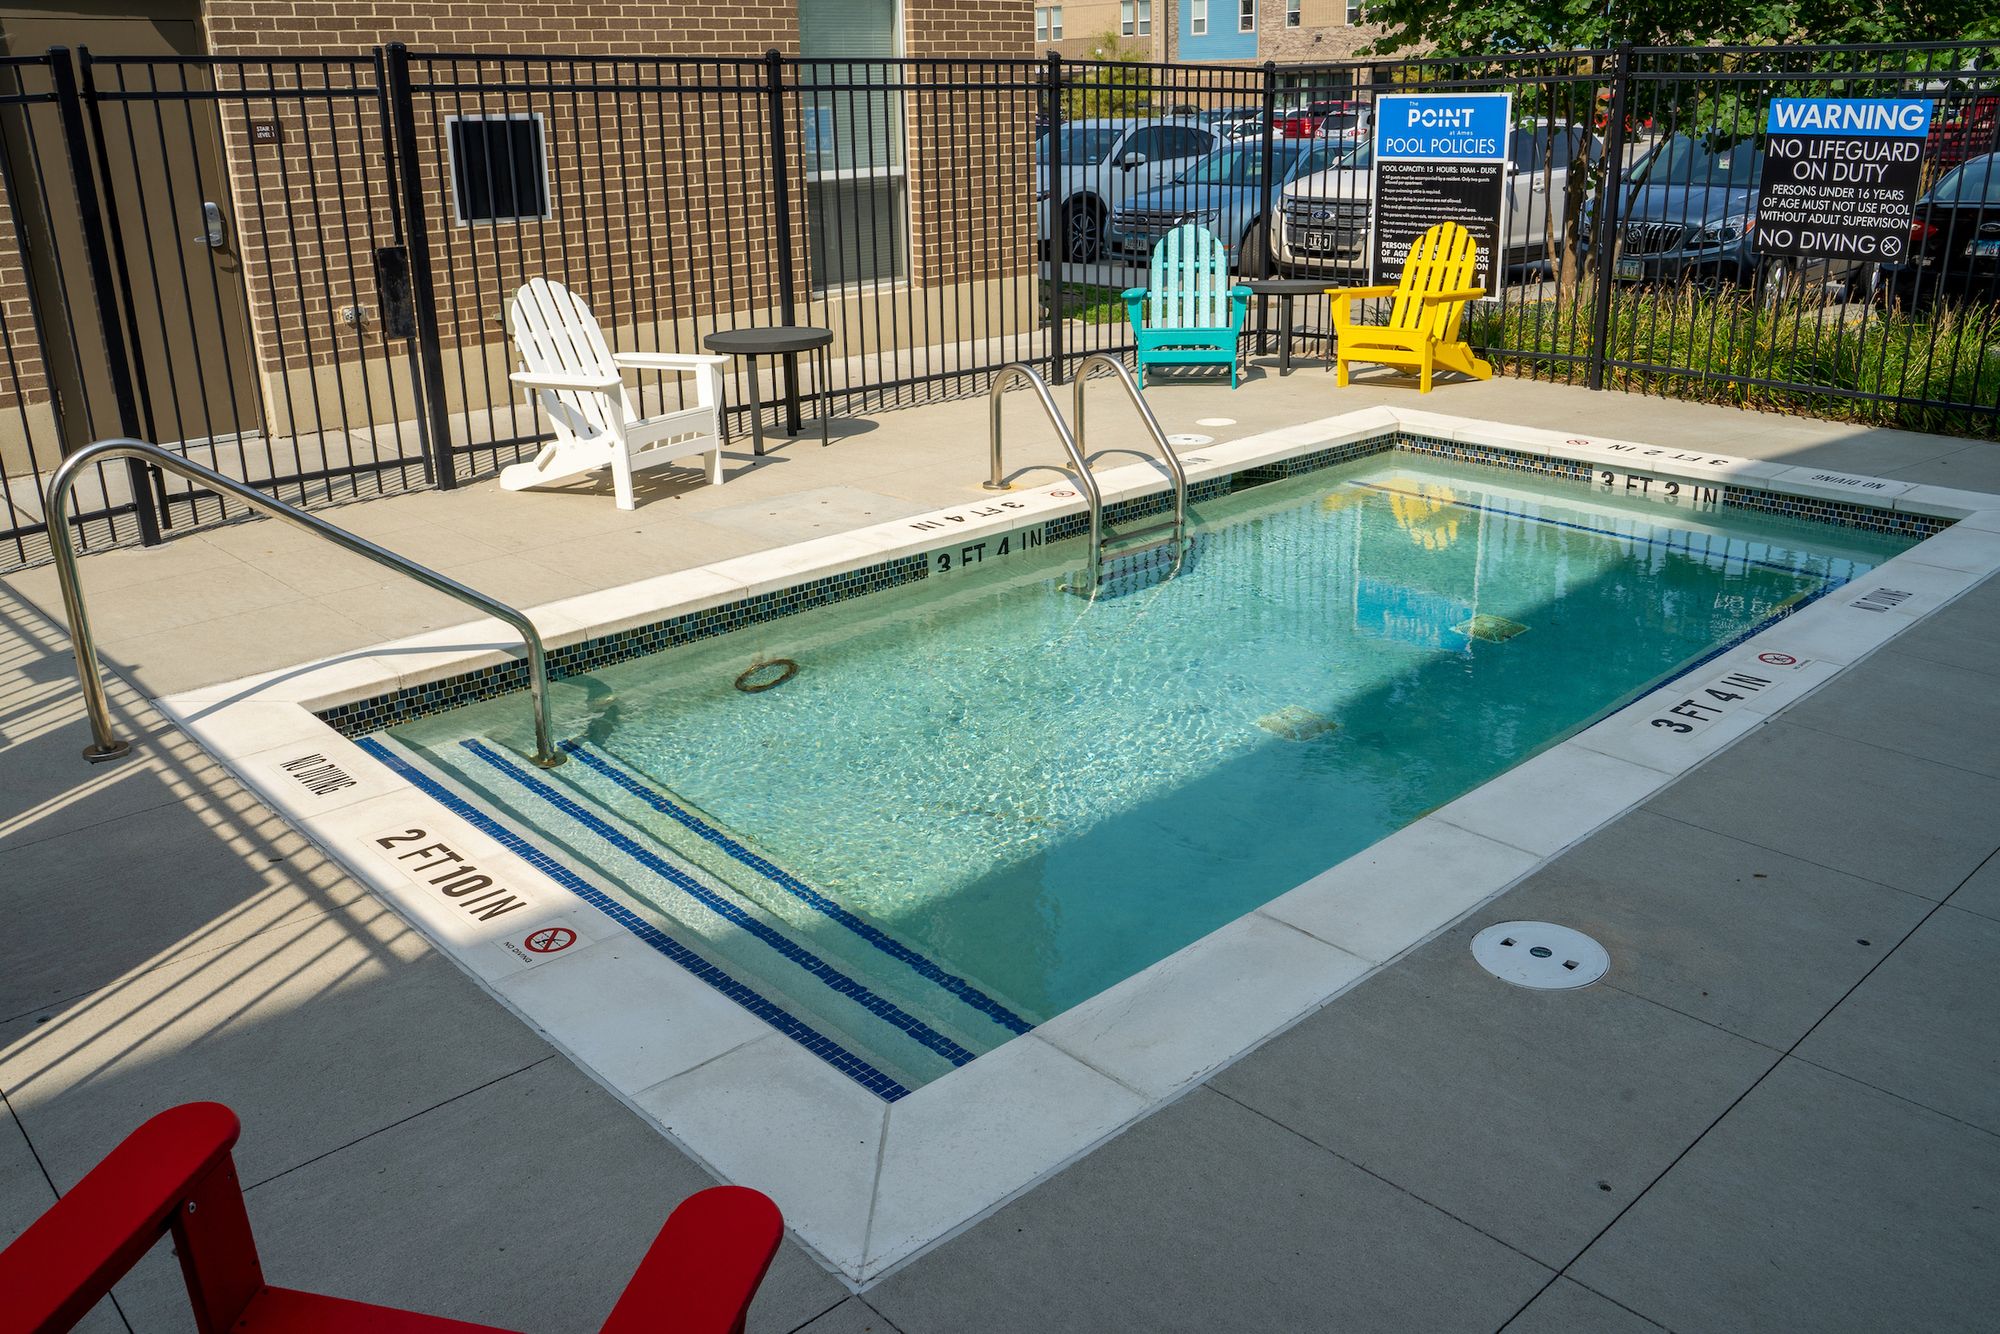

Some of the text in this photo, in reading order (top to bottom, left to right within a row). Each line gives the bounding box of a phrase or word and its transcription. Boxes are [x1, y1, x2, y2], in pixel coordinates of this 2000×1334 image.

[1408, 108, 1475, 128] POINT
[1775, 103, 1925, 131] WARNING
[1386, 138, 1496, 154] POOL POLICIES
[1769, 139, 1920, 162] NO LIFEGUARD
[1793, 161, 1889, 183] ON DUTY
[1772, 184, 1904, 201] PERSONS UNDER 16 YEARS
[1762, 197, 1910, 215] OF AGE MUST NOT USE POOL
[1760, 210, 1910, 229] WITHOUT ADULT SUPERVISION
[1382, 242, 1412, 250] PERSONS
[1758, 228, 1876, 254] NO DIVING
[1381, 257, 1407, 265] WITHO
[1607, 444, 1636, 452] IN
[1626, 474, 1653, 492] FT
[1694, 486, 1718, 504] IN
[1811, 474, 1861, 486] DIVING
[909, 501, 1025, 531] 3 FT 4 IN
[937, 528, 1042, 573] 3 FT 4 IN
[1650, 672, 1772, 734] 3 FT 4 IN
[280, 753, 357, 796] NO DIVING
[376, 828, 427, 850] 2
[504, 941, 533, 963] NO DIVING
